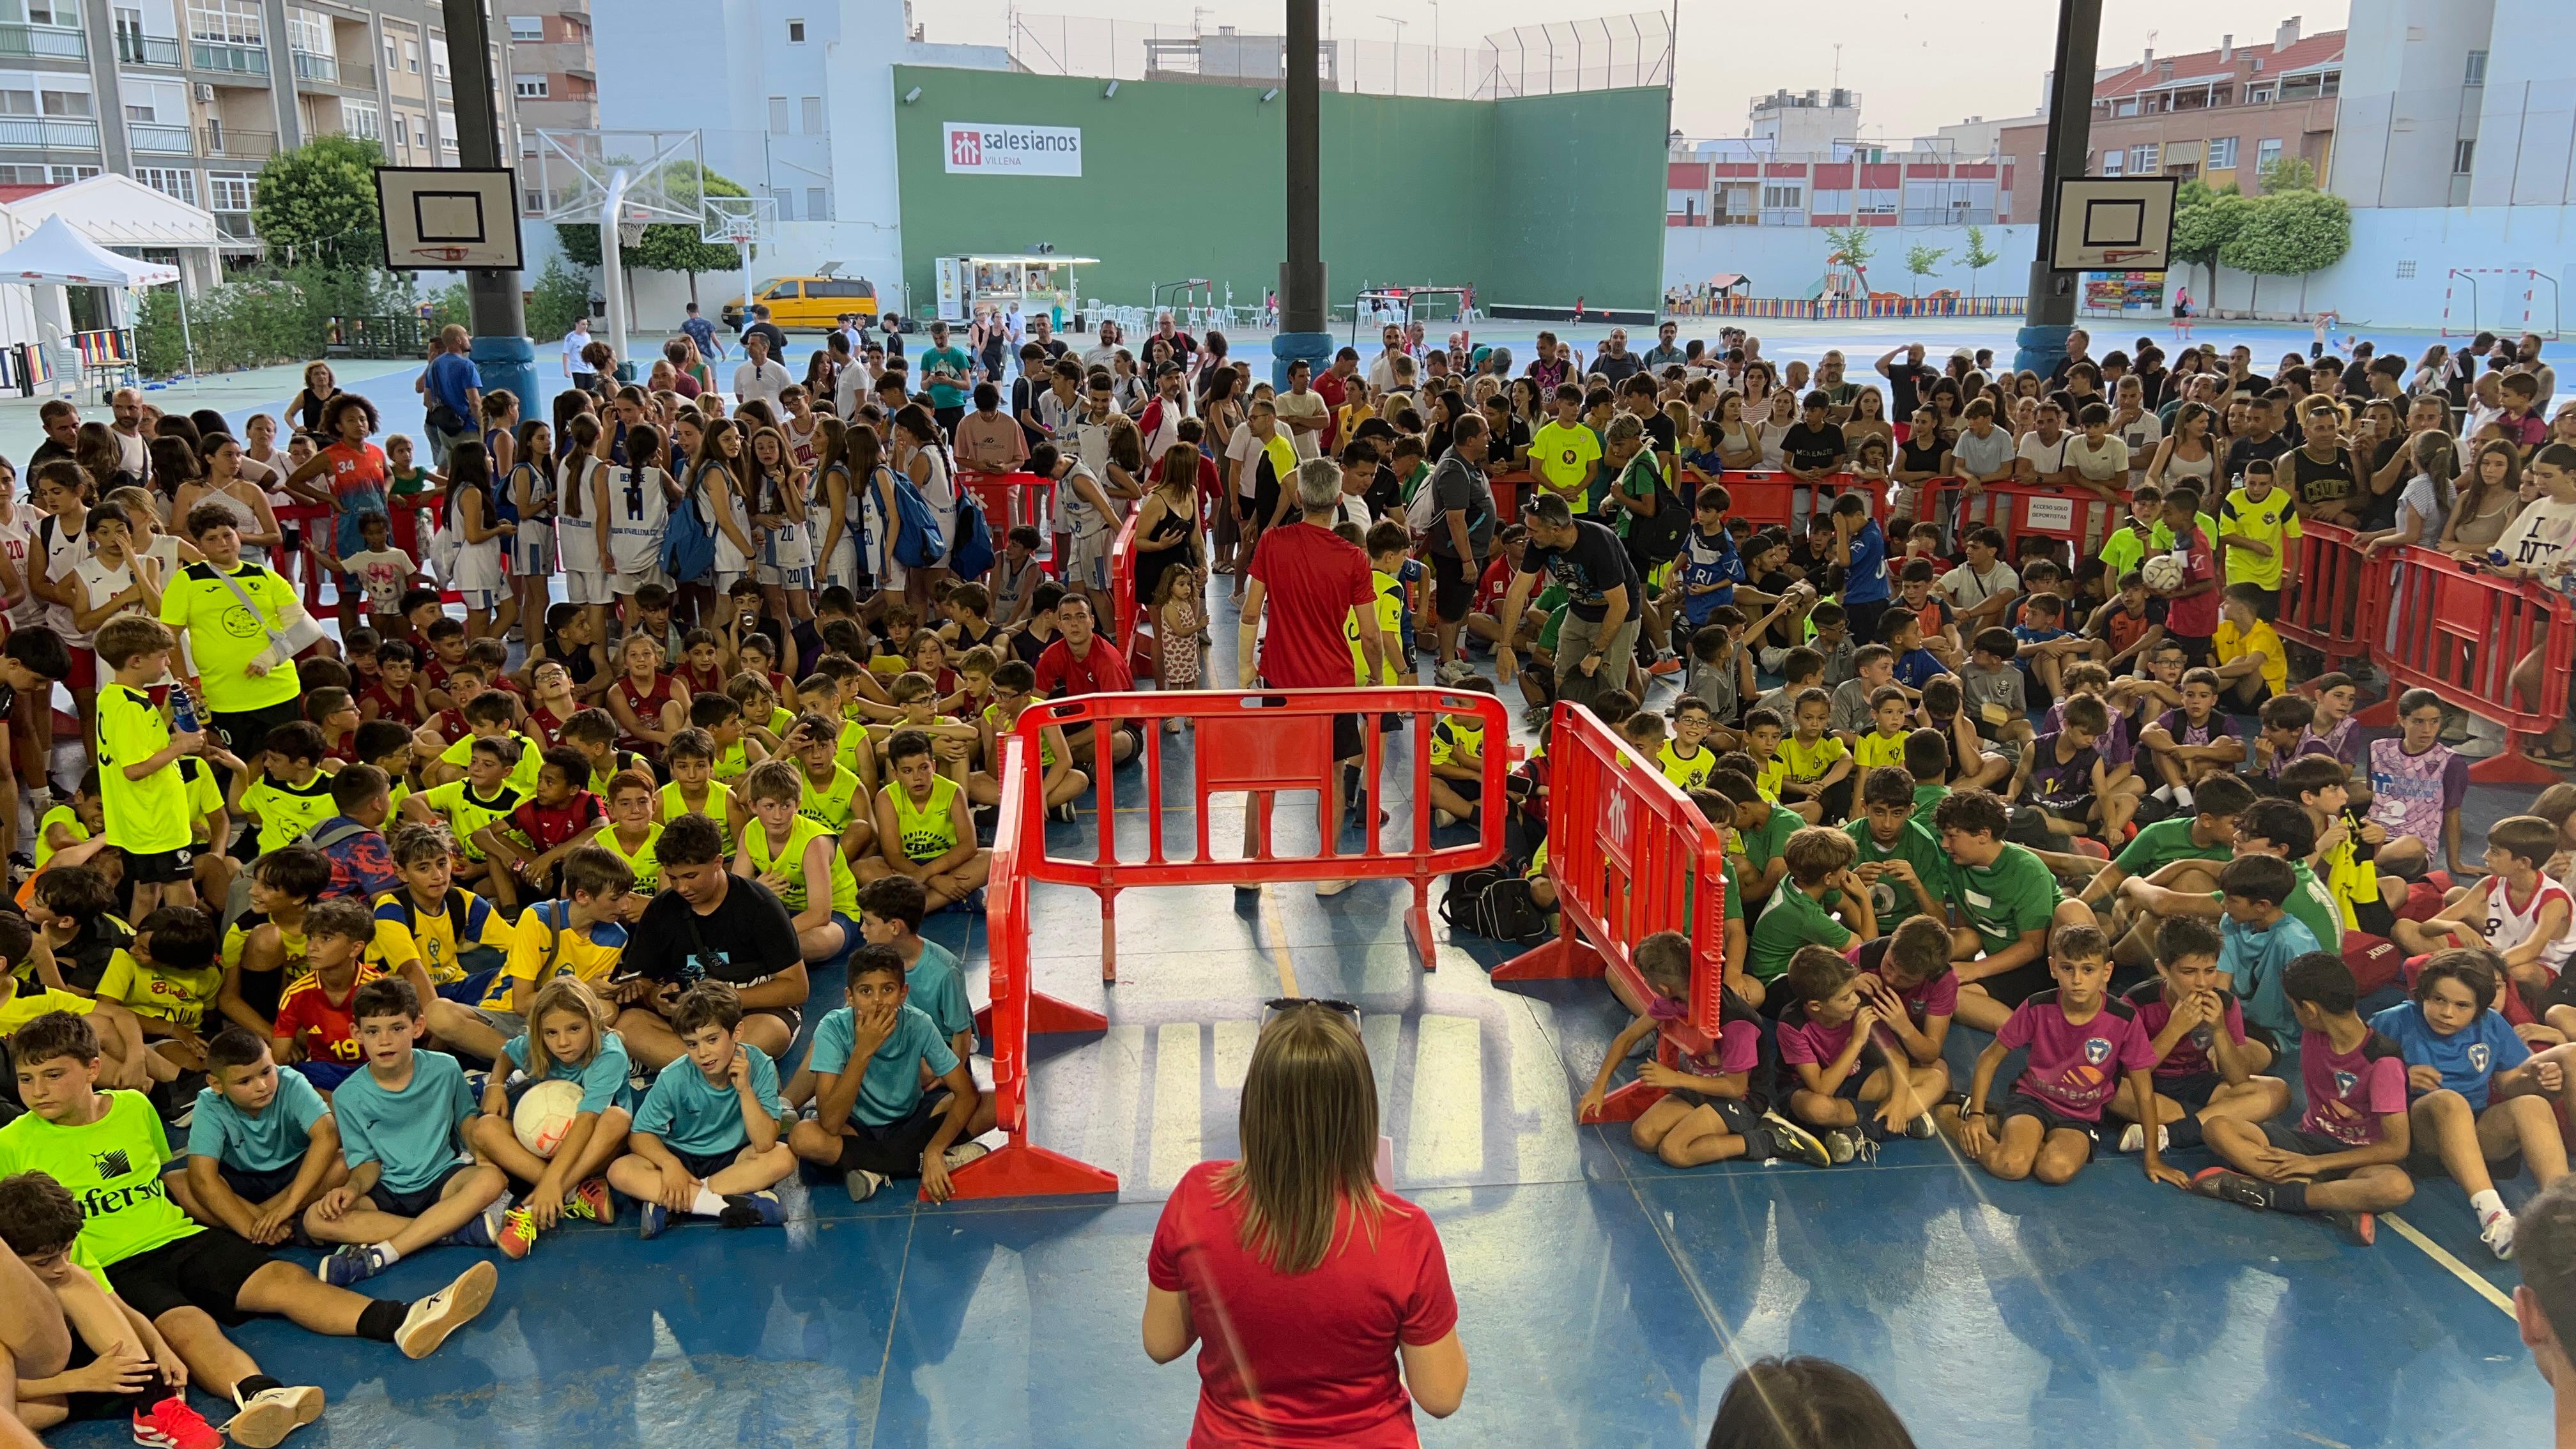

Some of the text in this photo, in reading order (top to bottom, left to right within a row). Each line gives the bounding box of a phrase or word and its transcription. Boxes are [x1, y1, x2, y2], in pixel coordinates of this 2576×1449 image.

[984, 130, 1077, 152] salesianos
[985, 157, 1022, 165] VILLENA
[1796, 448, 1833, 457] MCKENZIE
[338, 459, 355, 473] 34
[781, 525, 793, 542] 20
[2527, 516, 2546, 538] I
[6, 540, 24, 560] 20
[787, 569, 801, 583] 20
[2485, 918, 2502, 937] 8
[330, 1038, 360, 1061] 19
